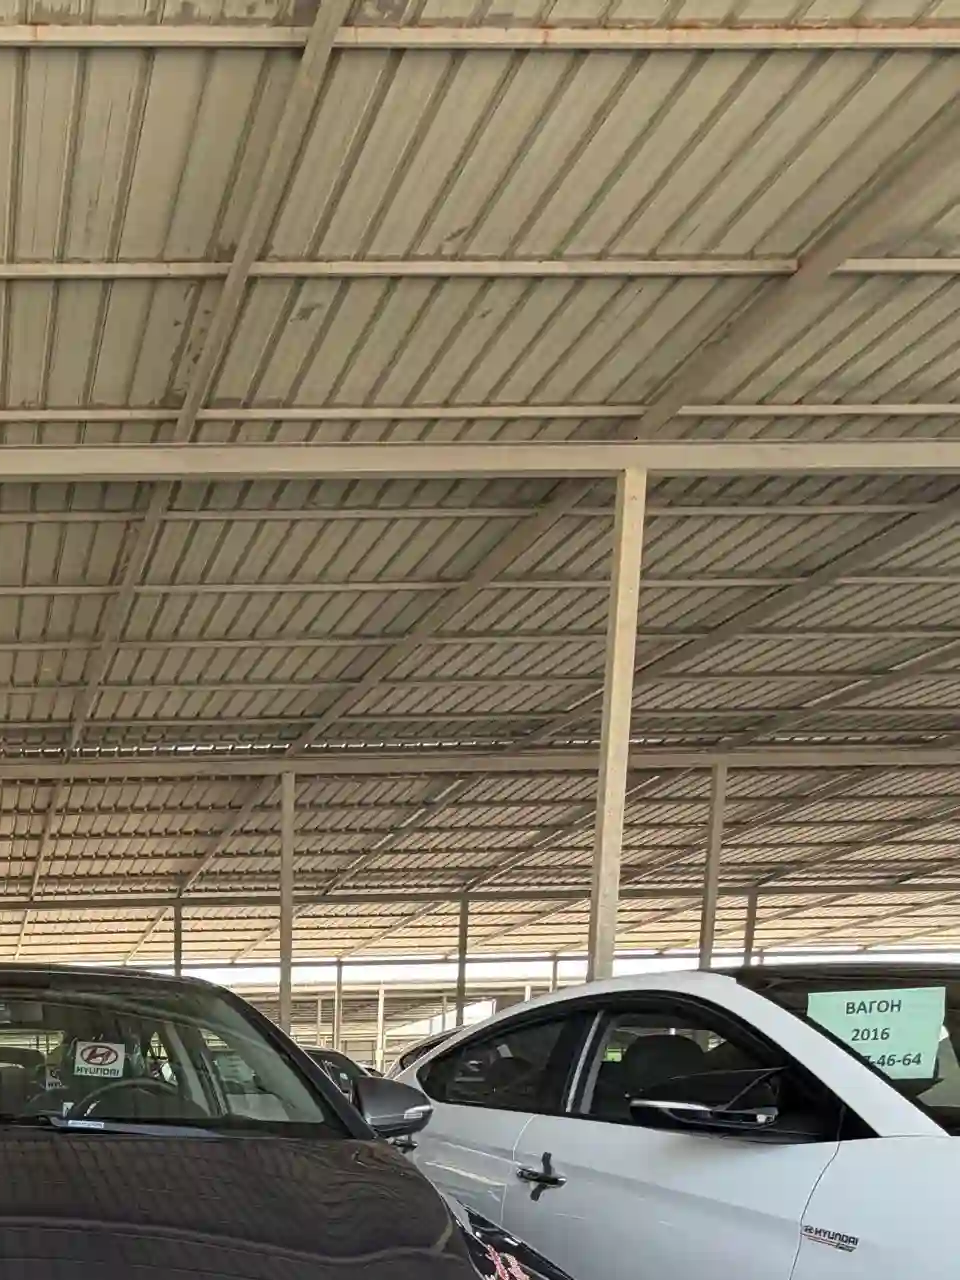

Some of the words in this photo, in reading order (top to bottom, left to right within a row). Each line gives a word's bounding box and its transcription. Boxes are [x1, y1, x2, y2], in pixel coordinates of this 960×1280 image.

[845, 999, 902, 1015] ВАГОН
[851, 1027, 890, 1041] 2016
[75, 1065, 120, 1076] HYUNDAI
[814, 1227, 859, 1246] HYUNDAI
